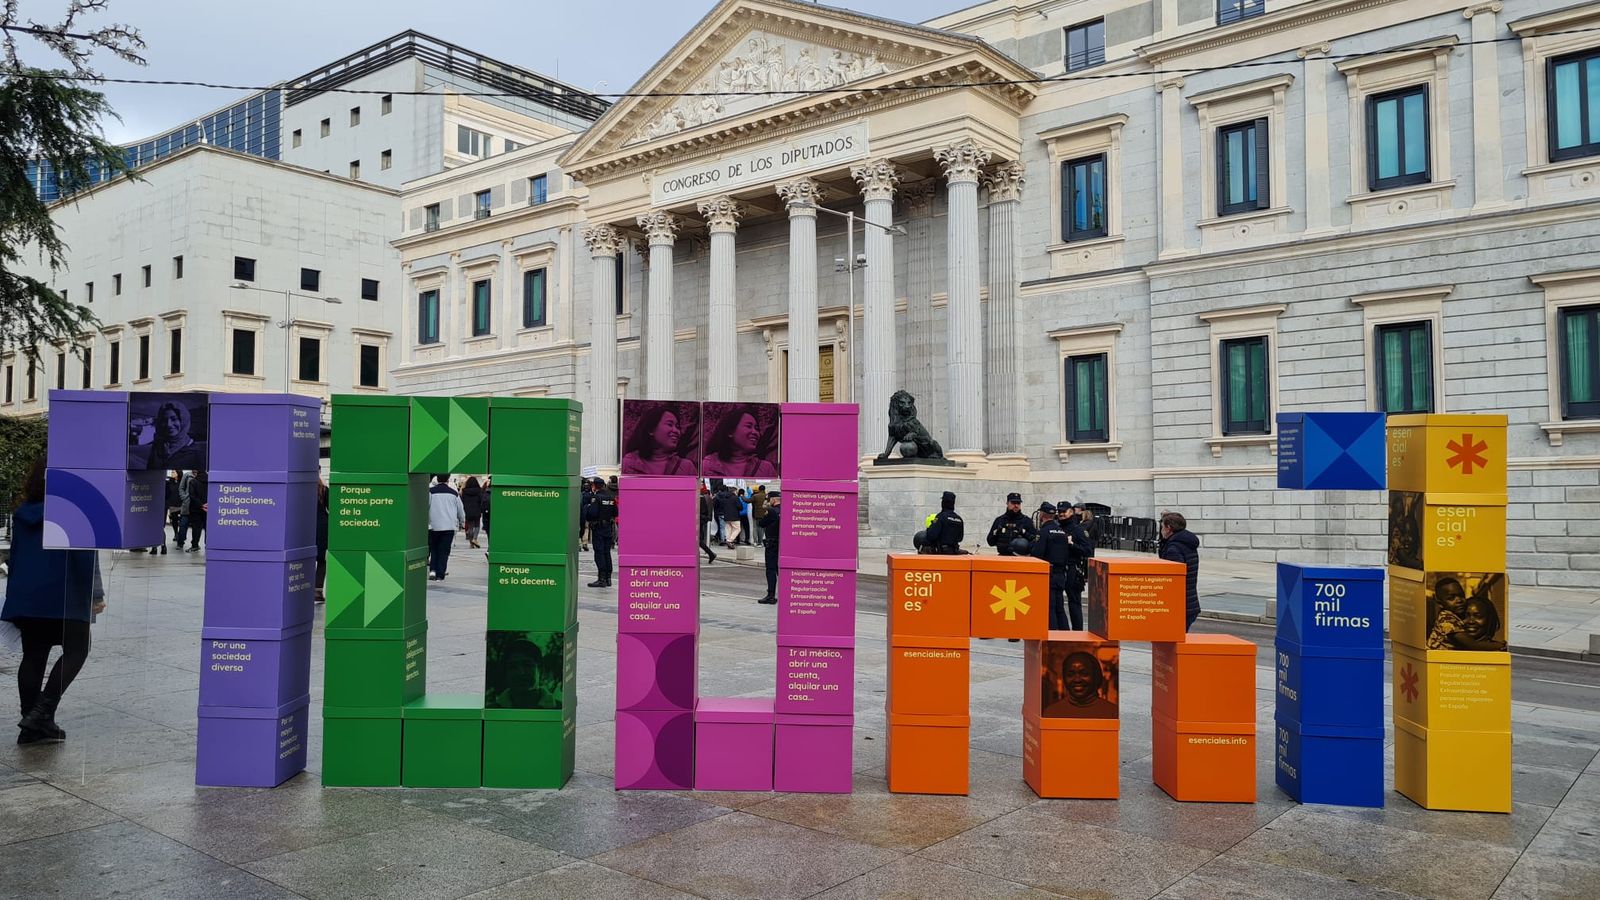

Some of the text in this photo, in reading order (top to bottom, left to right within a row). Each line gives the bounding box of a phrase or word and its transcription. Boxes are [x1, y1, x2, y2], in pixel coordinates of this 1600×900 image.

[662, 136, 853, 194] CONGRESO DE LOS DIPUTADOS
[1392, 428, 1412, 438] esen
[1392, 439, 1407, 453] cial
[219, 484, 252, 494] Iguales
[340, 486, 371, 494] Porque
[502, 490, 560, 498] esenciales.info
[218, 495, 276, 506] obligaciones,
[370, 498, 394, 507] parte
[218, 507, 249, 516] iguales
[1436, 506, 1476, 517] esen
[217, 518, 259, 526] derechos.
[340, 519, 380, 527] sociedad.
[1436, 518, 1466, 532] cial
[499, 565, 530, 575] Porque
[650, 569, 684, 578] médico,
[511, 577, 519, 585] lo
[521, 577, 557, 586] decente.
[904, 572, 942, 582] esen
[904, 583, 933, 597] cial
[1315, 584, 1346, 597] 700
[630, 591, 662, 599] cuenta,
[630, 602, 661, 610] alquilar
[1315, 598, 1340, 612] mil
[1315, 612, 1370, 628] firmas
[212, 641, 227, 649] Por
[211, 652, 251, 661] sociedad
[789, 649, 797, 657] Ir
[809, 650, 843, 659] médico,
[904, 650, 961, 659] esenciales.info
[788, 660, 809, 668] abrir
[1279, 652, 1289, 668] 700
[211, 663, 243, 671] diversa
[788, 672, 820, 680] cuenta,
[788, 682, 820, 691] alquilar
[1279, 680, 1297, 701] firmas
[1279, 727, 1289, 744] 700
[1188, 737, 1248, 745] esenciales.info
